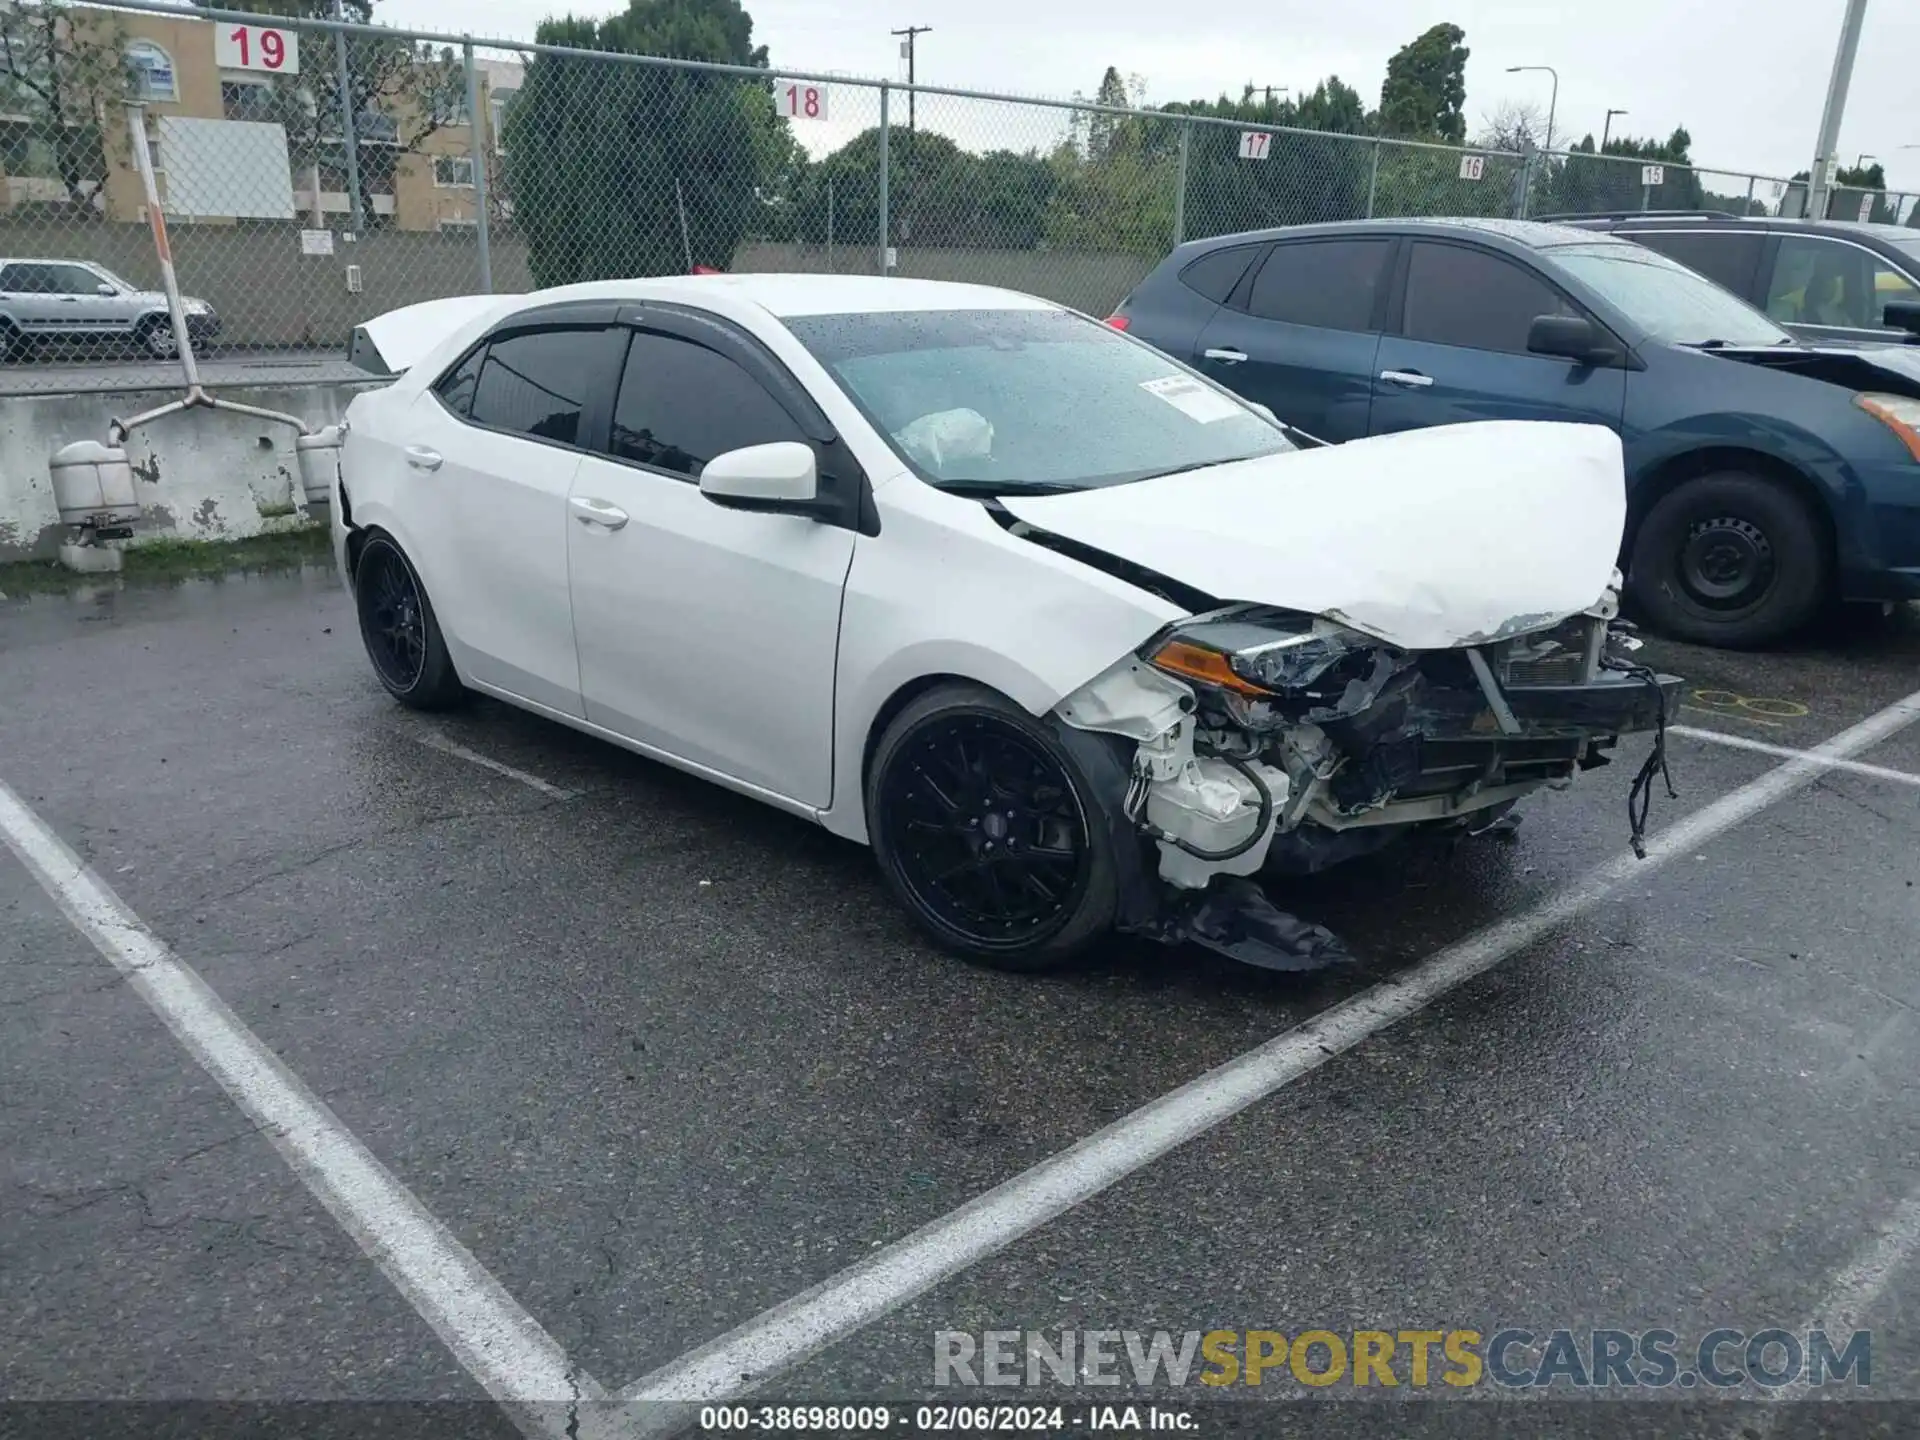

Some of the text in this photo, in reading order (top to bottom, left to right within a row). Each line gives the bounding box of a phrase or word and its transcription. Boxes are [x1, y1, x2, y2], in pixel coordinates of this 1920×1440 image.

[230, 26, 285, 69] 19
[786, 84, 819, 118] 18
[1247, 133, 1268, 157] 17
[1465, 158, 1480, 178] 16
[1646, 167, 1661, 183] 15
